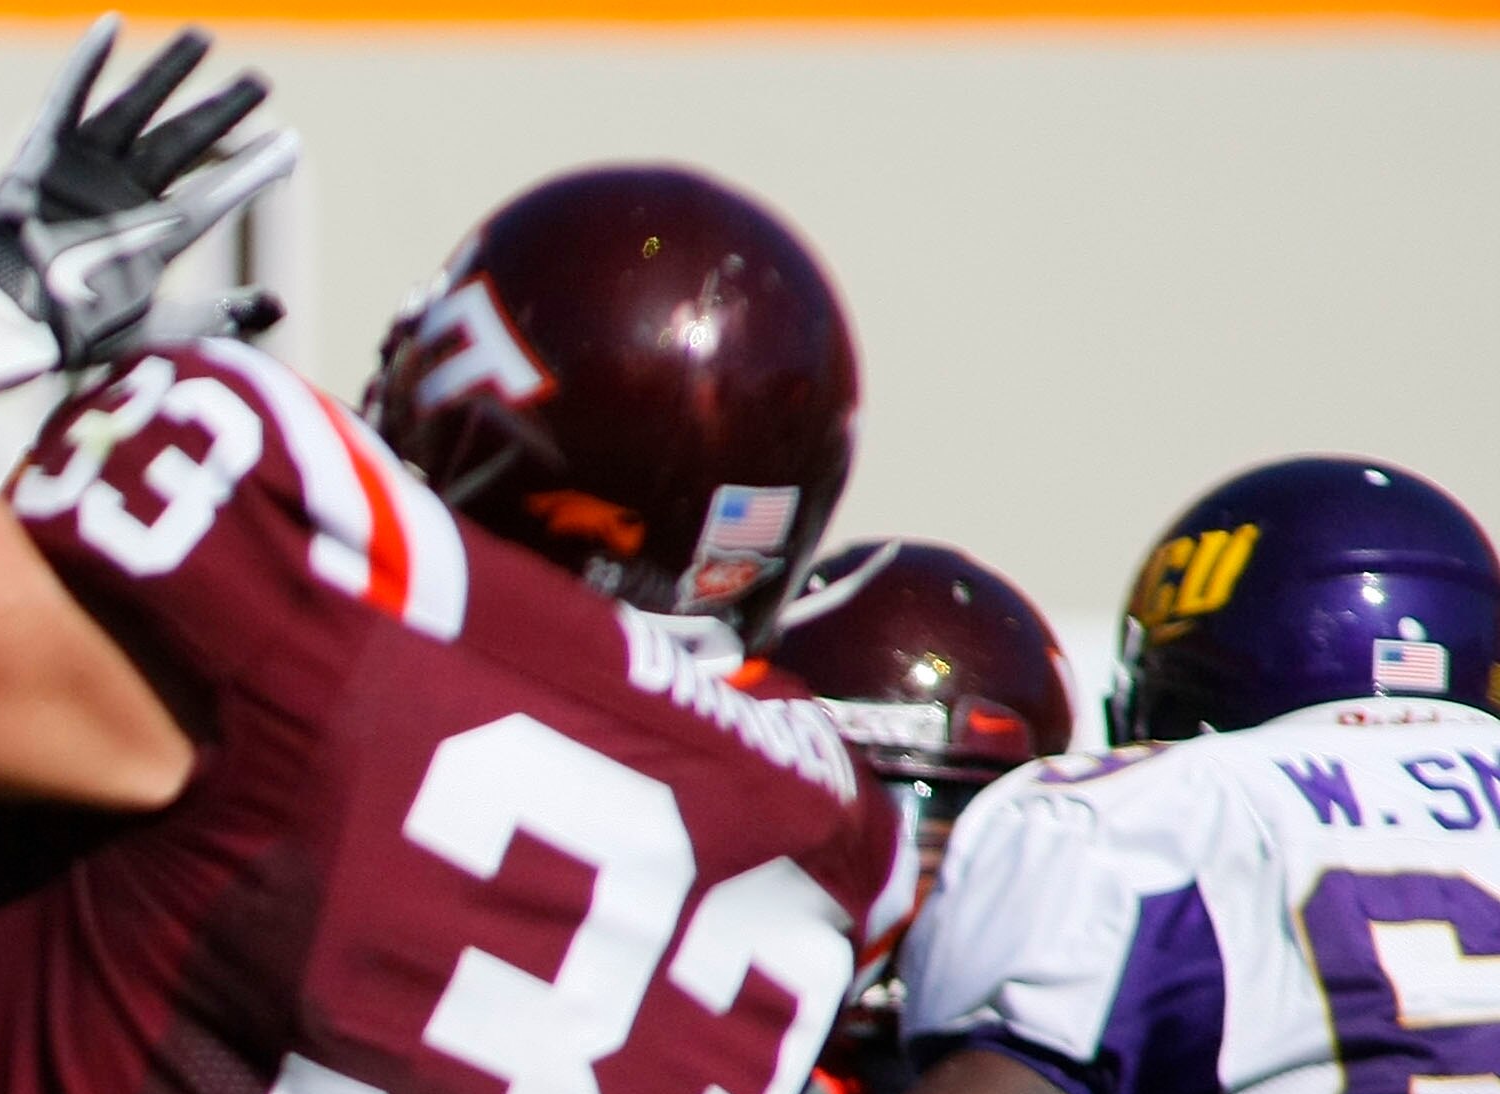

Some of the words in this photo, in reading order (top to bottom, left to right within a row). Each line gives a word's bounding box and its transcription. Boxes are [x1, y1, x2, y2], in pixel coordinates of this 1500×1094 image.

[8, 352, 265, 578] 33
[1132, 522, 1260, 628] CU
[1270, 752, 1400, 828] W.
